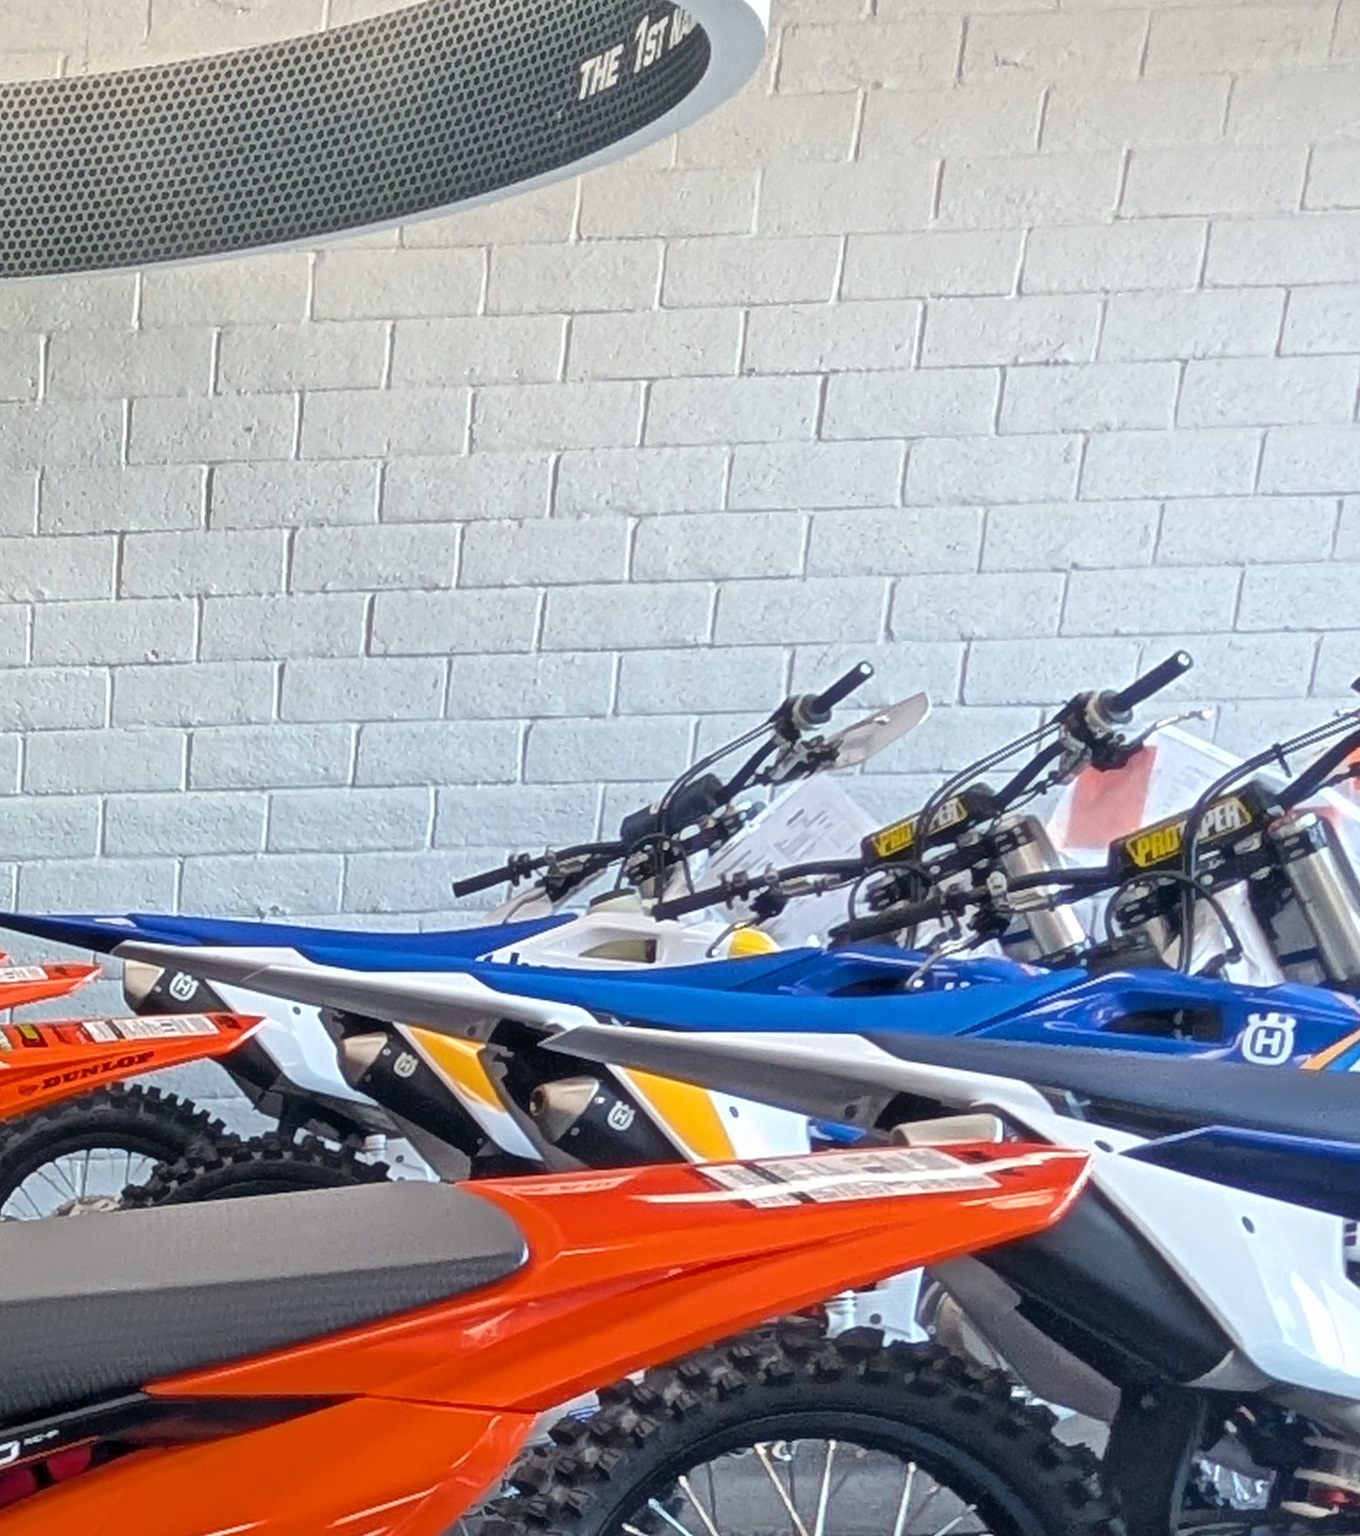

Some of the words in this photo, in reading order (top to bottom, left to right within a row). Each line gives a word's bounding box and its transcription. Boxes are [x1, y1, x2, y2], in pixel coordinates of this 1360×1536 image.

[579, 43, 624, 100] THE
[633, 14, 670, 74] 1ST
[42, 1052, 155, 1089] DUNLOP
